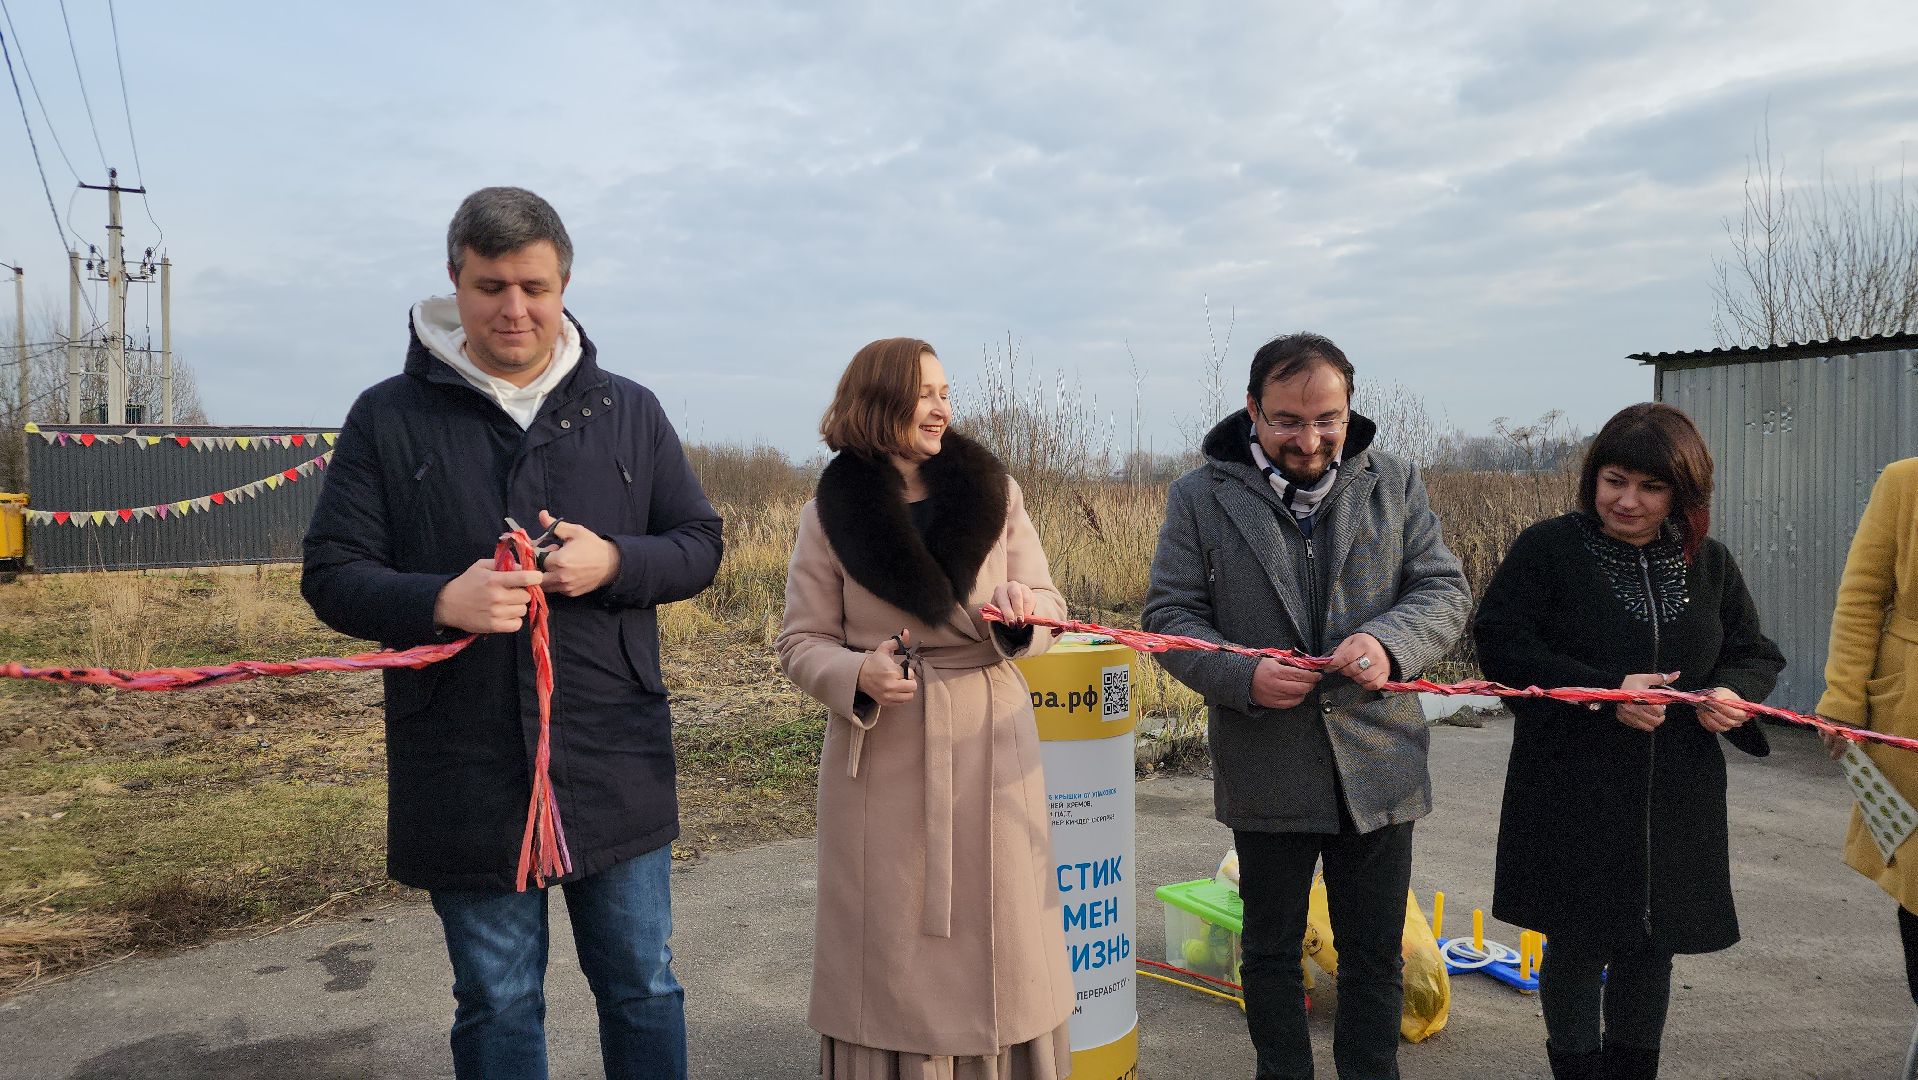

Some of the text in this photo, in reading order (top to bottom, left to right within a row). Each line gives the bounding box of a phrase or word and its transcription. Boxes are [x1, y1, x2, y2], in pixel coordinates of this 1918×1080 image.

[1056, 855, 1122, 892] СТИК
[1063, 896, 1118, 932] МЕН
[1067, 933, 1130, 972] ИЗНЬ
